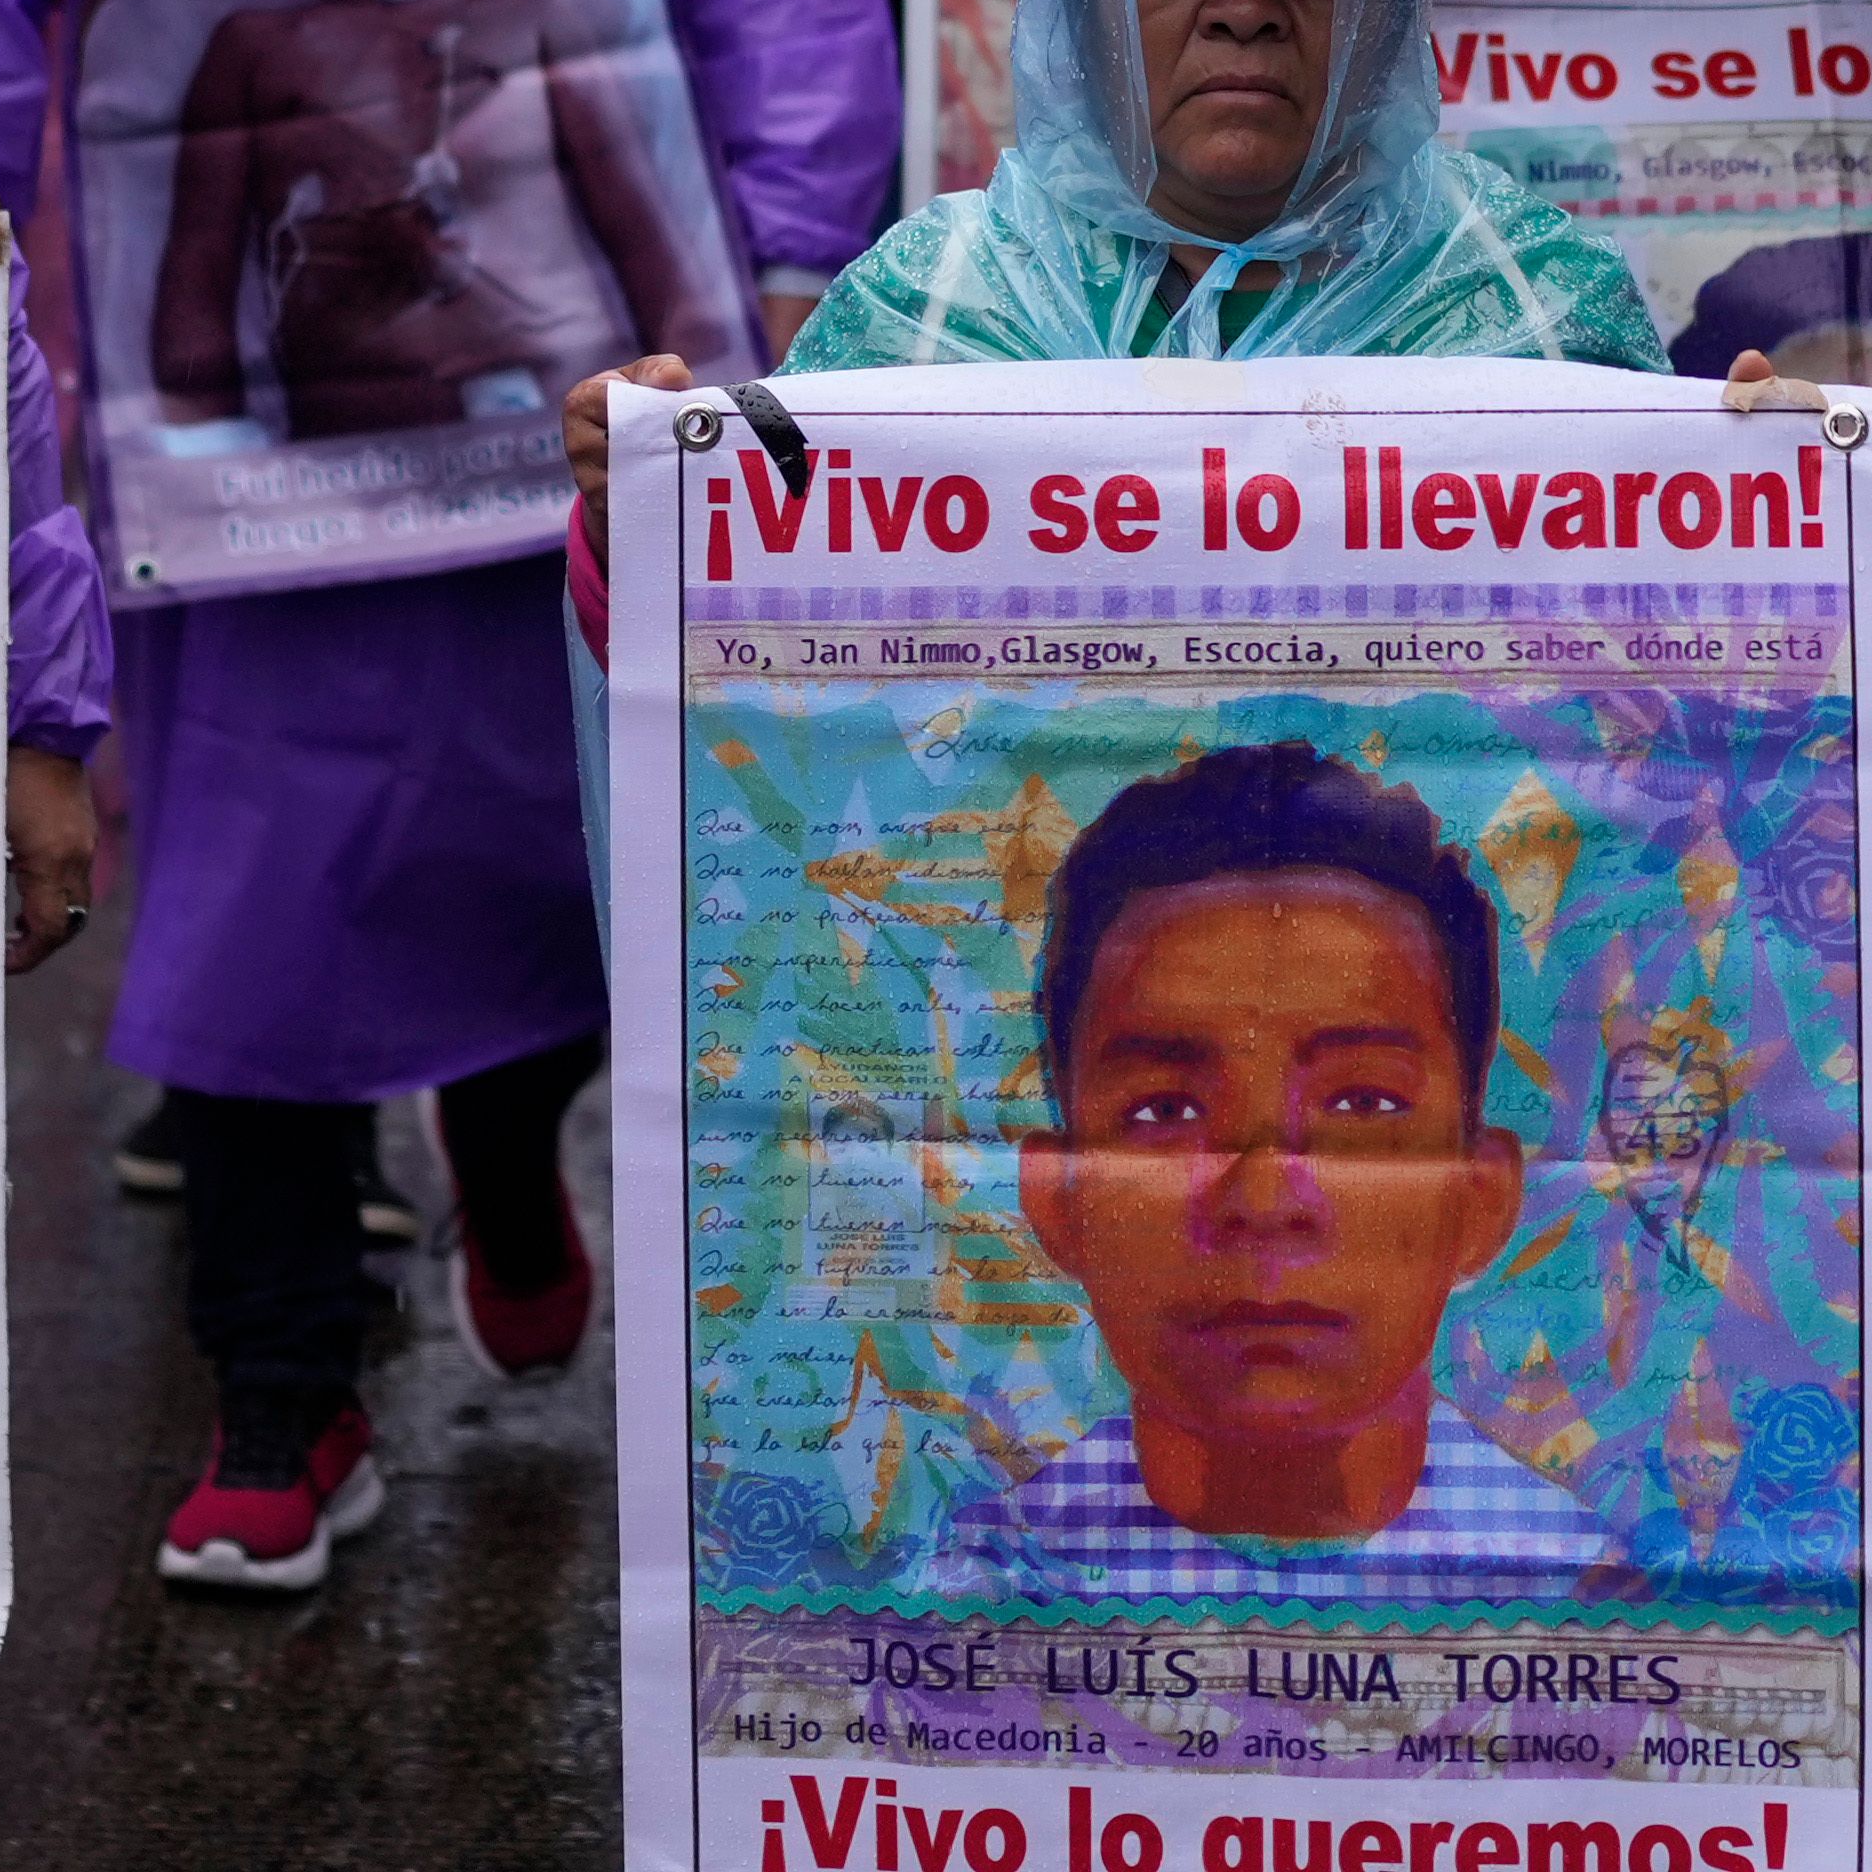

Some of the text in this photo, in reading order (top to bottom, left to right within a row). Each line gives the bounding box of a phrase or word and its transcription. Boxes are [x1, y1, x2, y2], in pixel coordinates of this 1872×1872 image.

[1651, 48, 1756, 98] se
[1789, 27, 1871, 96] lo
[707, 446, 1824, 581] ¡Vivo se lo llevaron!
[716, 639, 772, 669] Yo,
[801, 639, 858, 664] Jan
[1185, 637, 1340, 668] Escocia,
[1365, 637, 1484, 669] quiero
[1506, 634, 1605, 663] saber
[1626, 634, 1723, 662] dónde
[1745, 631, 1823, 661] está
[849, 1631, 996, 1693] JOSÉ
[1247, 1650, 1401, 1703] LUNA
[1444, 1652, 1682, 1706] TORRES
[734, 1713, 822, 1749] Hijo
[845, 1714, 888, 1745] de
[907, 1719, 1107, 1756] Macedonia
[1177, 1729, 1220, 1758] 20
[1243, 1729, 1327, 1763] años
[1395, 1733, 1617, 1769] AMILCINGO,
[1643, 1736, 1803, 1769] MORELOS
[1069, 1785, 1165, 1872] lo
